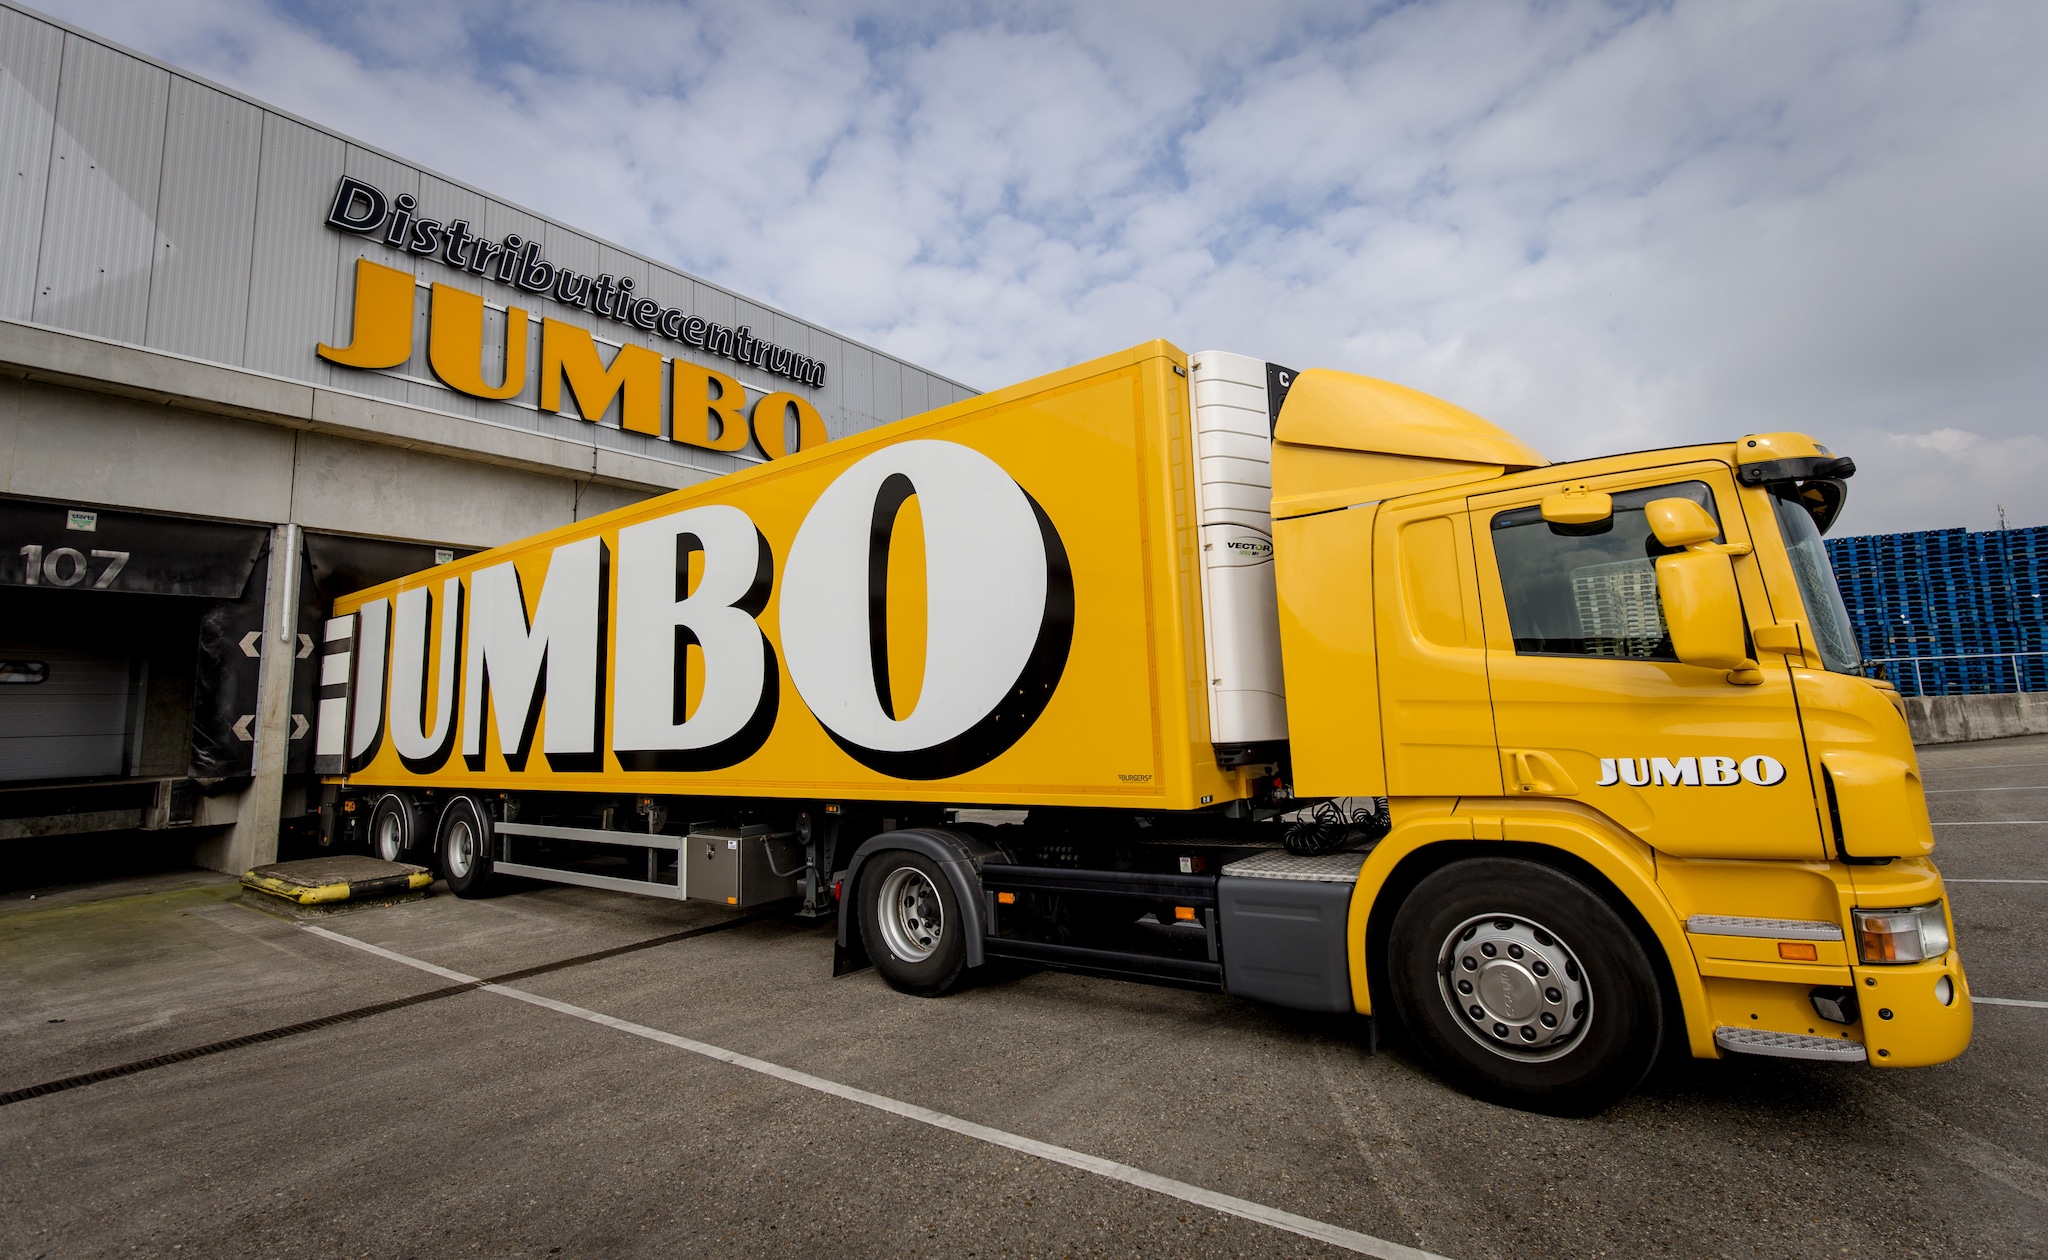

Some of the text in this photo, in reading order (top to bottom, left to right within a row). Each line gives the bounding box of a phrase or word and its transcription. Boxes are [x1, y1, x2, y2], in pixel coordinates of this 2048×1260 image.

[325, 175, 828, 388] Distributiecentrum
[317, 258, 828, 462] JUMBO
[20, 544, 130, 589] 107
[1227, 542, 1271, 552] VECTOR
[350, 439, 1075, 781] JUMBO
[1596, 755, 1787, 787] JUMBO
